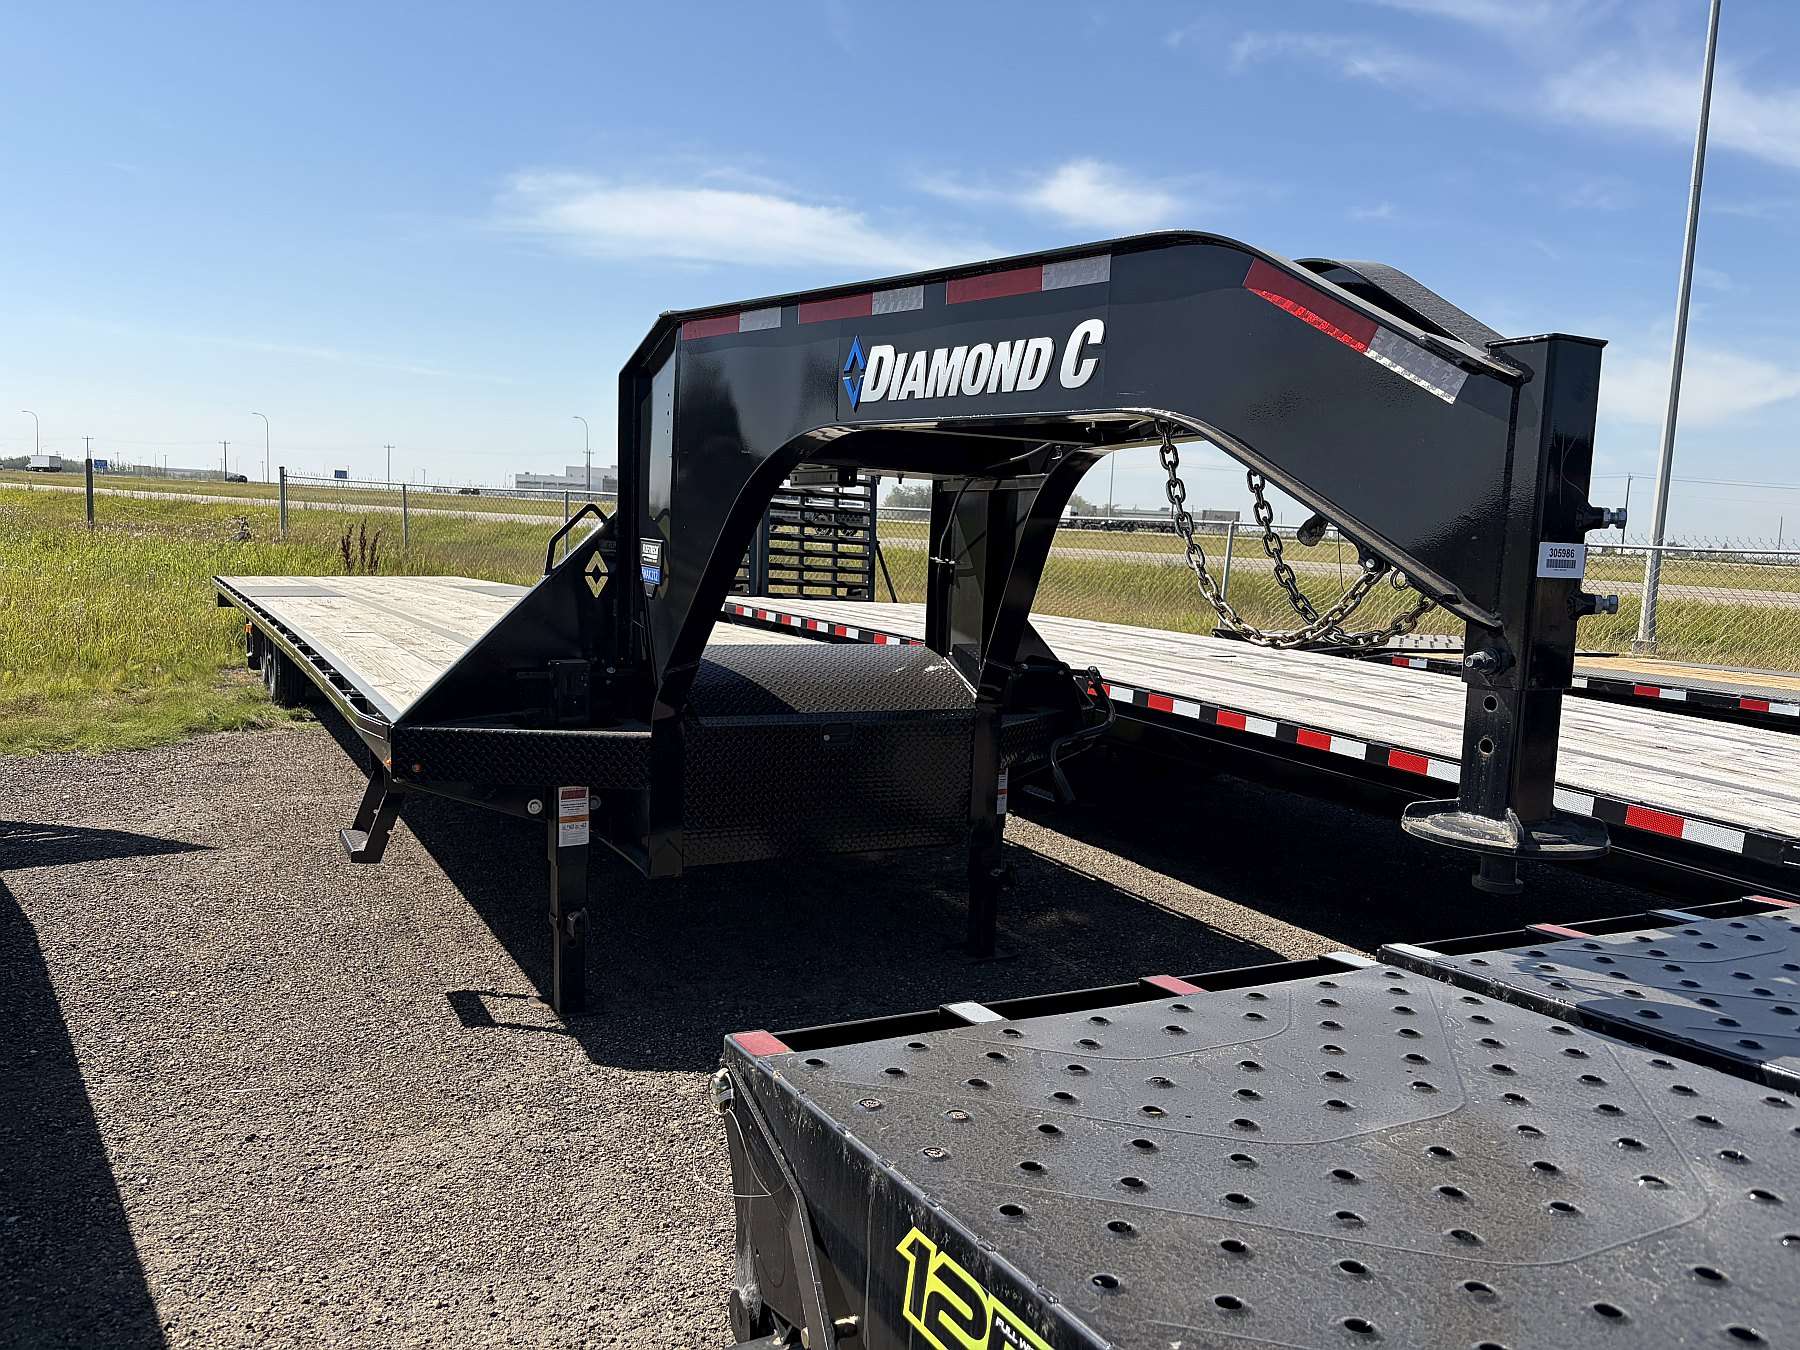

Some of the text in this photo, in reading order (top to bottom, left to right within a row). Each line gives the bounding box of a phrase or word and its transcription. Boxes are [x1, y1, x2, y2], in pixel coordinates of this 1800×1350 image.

[859, 318, 1106, 403] DIAMOND C
[1548, 547, 1576, 558] 305986
[995, 1315, 1018, 1344] FULL
